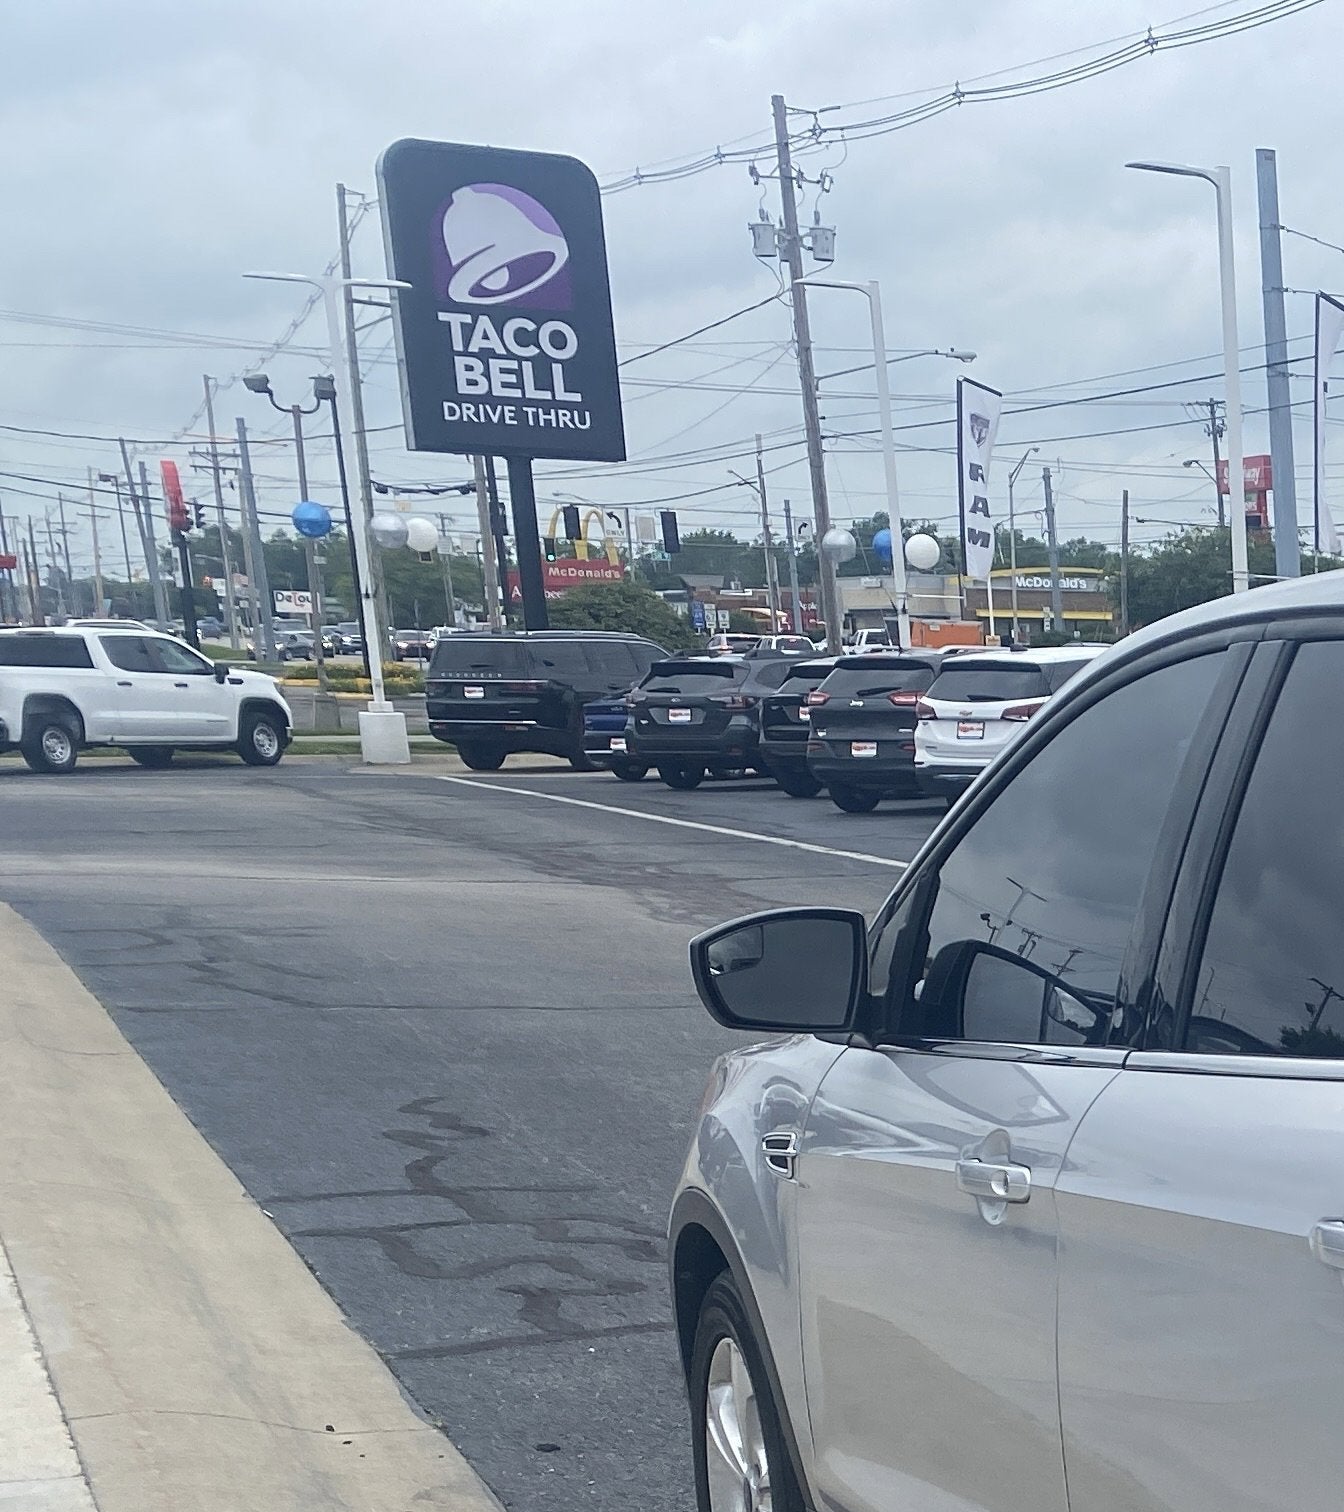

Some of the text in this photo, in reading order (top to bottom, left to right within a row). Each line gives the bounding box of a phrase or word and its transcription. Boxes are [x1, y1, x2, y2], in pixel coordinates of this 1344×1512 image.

[437, 311, 578, 360] TACO
[453, 355, 582, 402] BELL
[442, 401, 591, 429] DRIVE THRU
[967, 462, 991, 549] RAM
[548, 567, 621, 579] McDonald's
[1015, 576, 1087, 589] McDoald's
